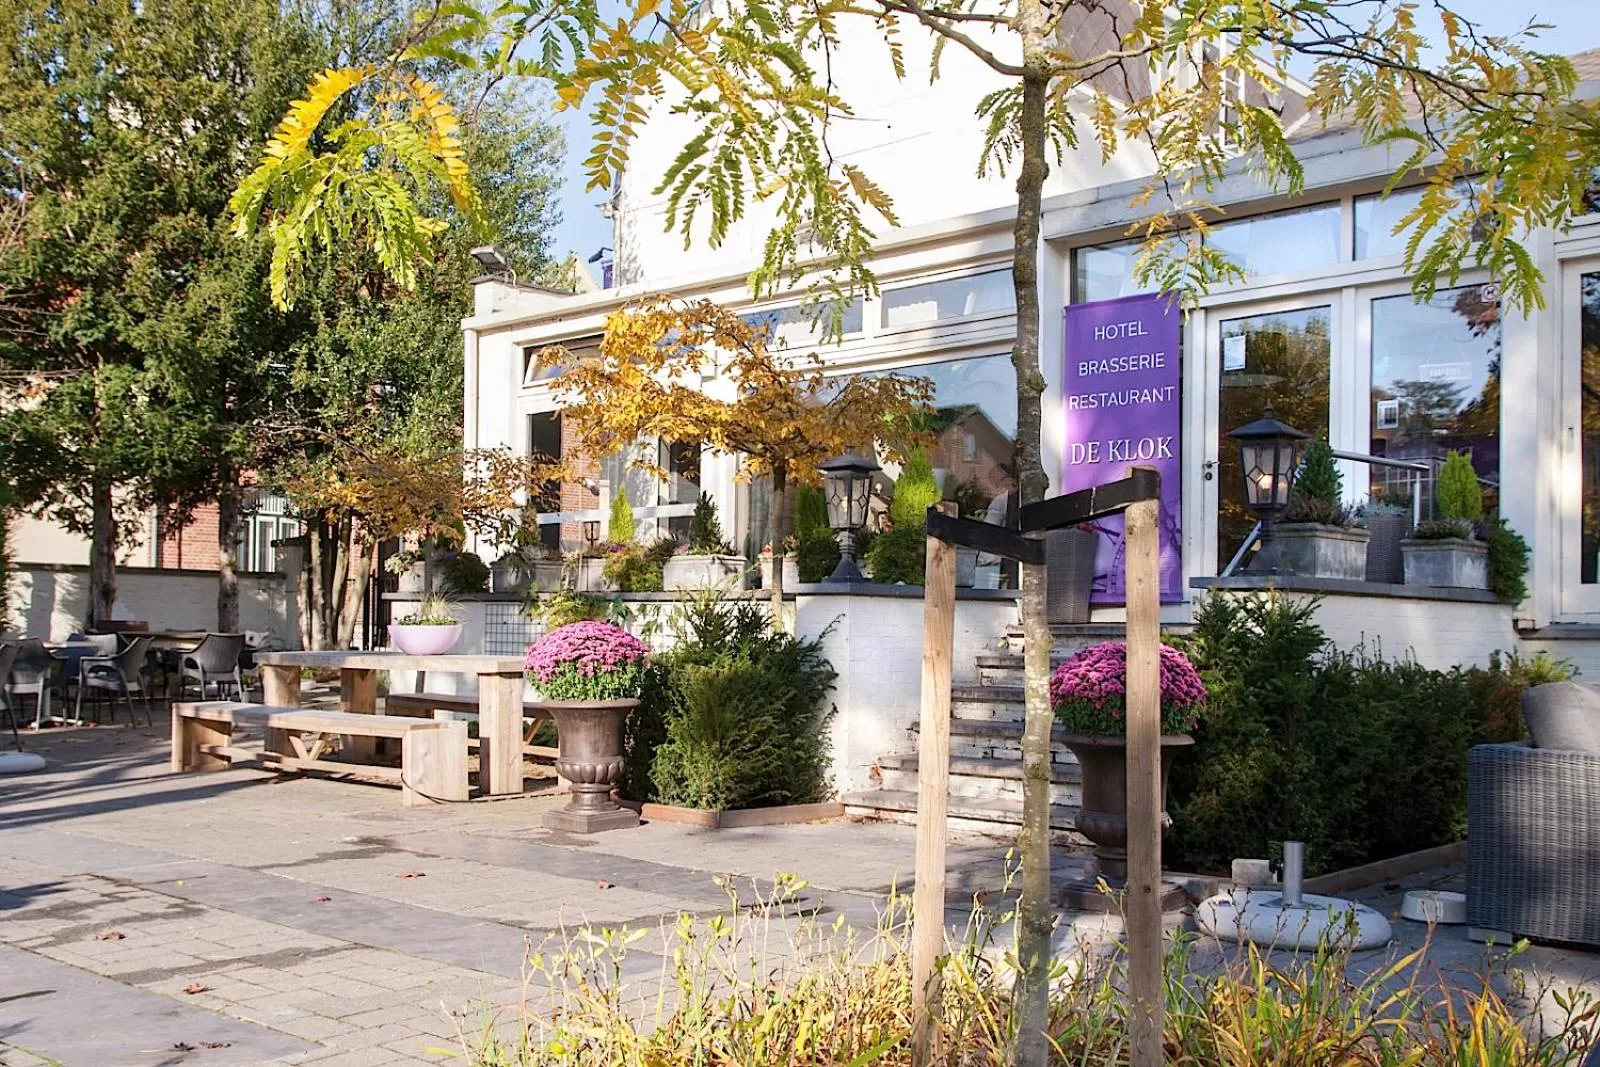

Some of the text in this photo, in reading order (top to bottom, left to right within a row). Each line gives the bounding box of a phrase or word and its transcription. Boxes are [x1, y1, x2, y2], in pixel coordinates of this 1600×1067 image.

[1094, 321, 1148, 341] HOTEL
[1078, 352, 1165, 377] BRASSERIE
[1069, 386, 1175, 411] RESTAURANT
[1070, 436, 1173, 465] DE KLOK
